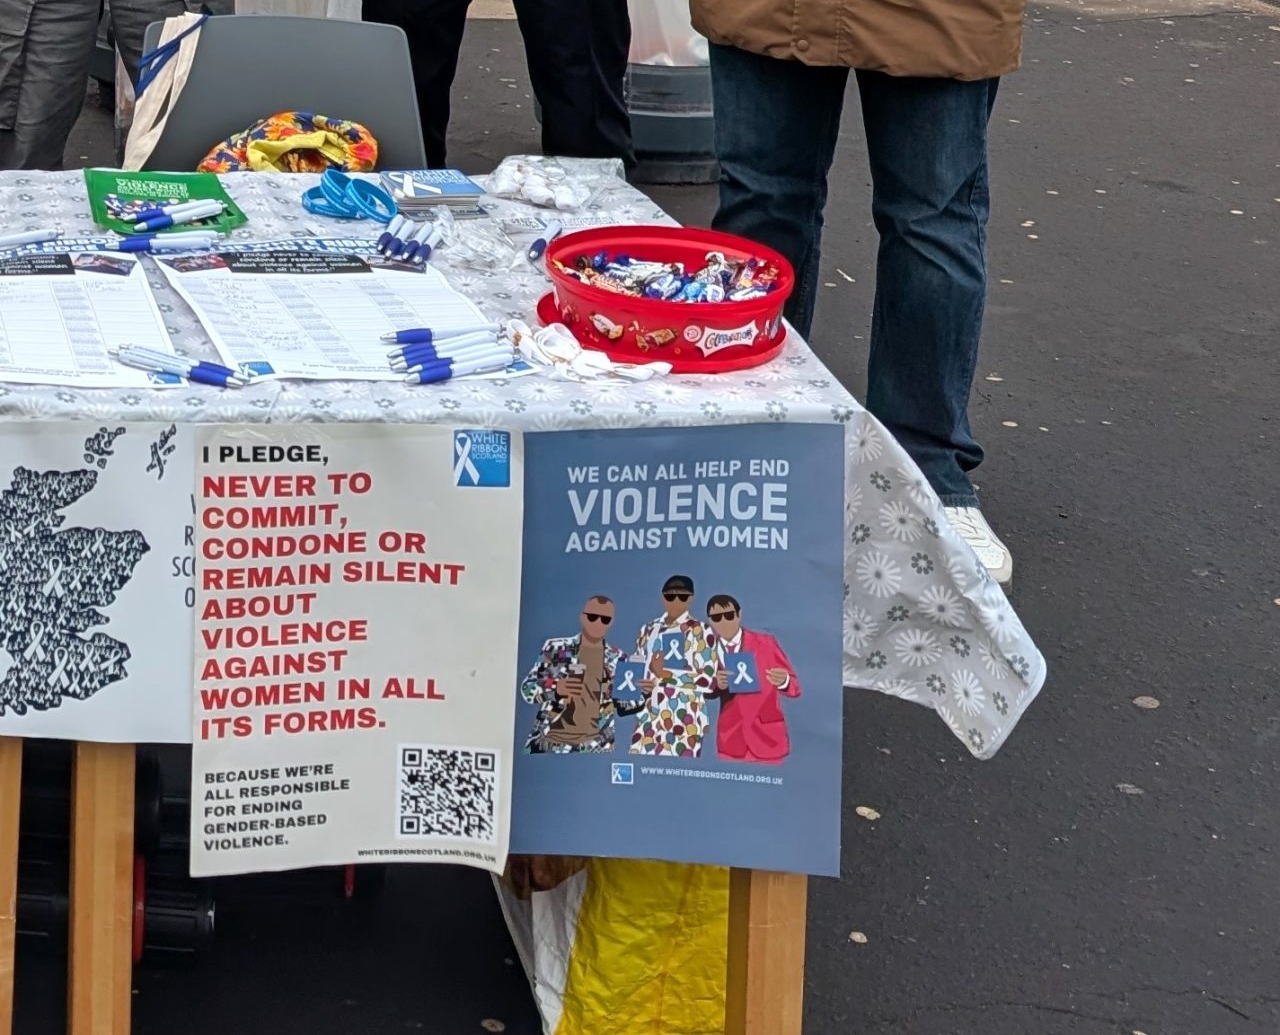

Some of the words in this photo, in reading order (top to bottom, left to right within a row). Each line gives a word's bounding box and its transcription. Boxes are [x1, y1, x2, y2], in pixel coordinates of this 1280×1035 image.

[322, 239, 378, 247] RIBBO
[471, 432, 508, 444] WHITE
[471, 444, 508, 453] RIBBON
[202, 446, 209, 463] I
[219, 444, 329, 466] PLEDGE,
[471, 452, 507, 460] SCOTLAND
[567, 466, 599, 483] WE
[607, 465, 648, 483] CAN
[655, 463, 687, 481] ALL
[694, 460, 741, 478] HELP
[749, 459, 790, 477] END
[202, 475, 317, 499] NEVER
[327, 472, 372, 495] TO
[567, 482, 788, 526] VIOLENCE
[202, 504, 348, 530] COMMIT,
[202, 532, 367, 560] CONDONE
[378, 531, 426, 553] OR
[565, 527, 677, 553] AGAINST
[686, 525, 789, 550] WOMEN
[202, 564, 331, 591] REMAIN
[343, 561, 466, 586] SILENT
[201, 593, 317, 621] ABOUT
[201, 620, 368, 650] VIOLENCE
[200, 650, 348, 681] AGAINST
[200, 681, 326, 710] WOMEN
[337, 678, 370, 701] IN
[382, 677, 446, 701] ALL
[201, 716, 253, 741] ITS
[263, 707, 386, 735] FORMS.
[204, 768, 280, 784] BECAUSE
[284, 764, 334, 778] WE'RE
[204, 788, 234, 802] ALL
[239, 779, 351, 799] RESPONSIBLE
[204, 804, 237, 818] FOR
[241, 800, 303, 815] ENDING
[204, 814, 328, 835] GENDER-BASED
[204, 834, 289, 851] VIOLENCE.
[357, 849, 497, 863] WHITERIBBONSCOTLAND.ORG.UK
